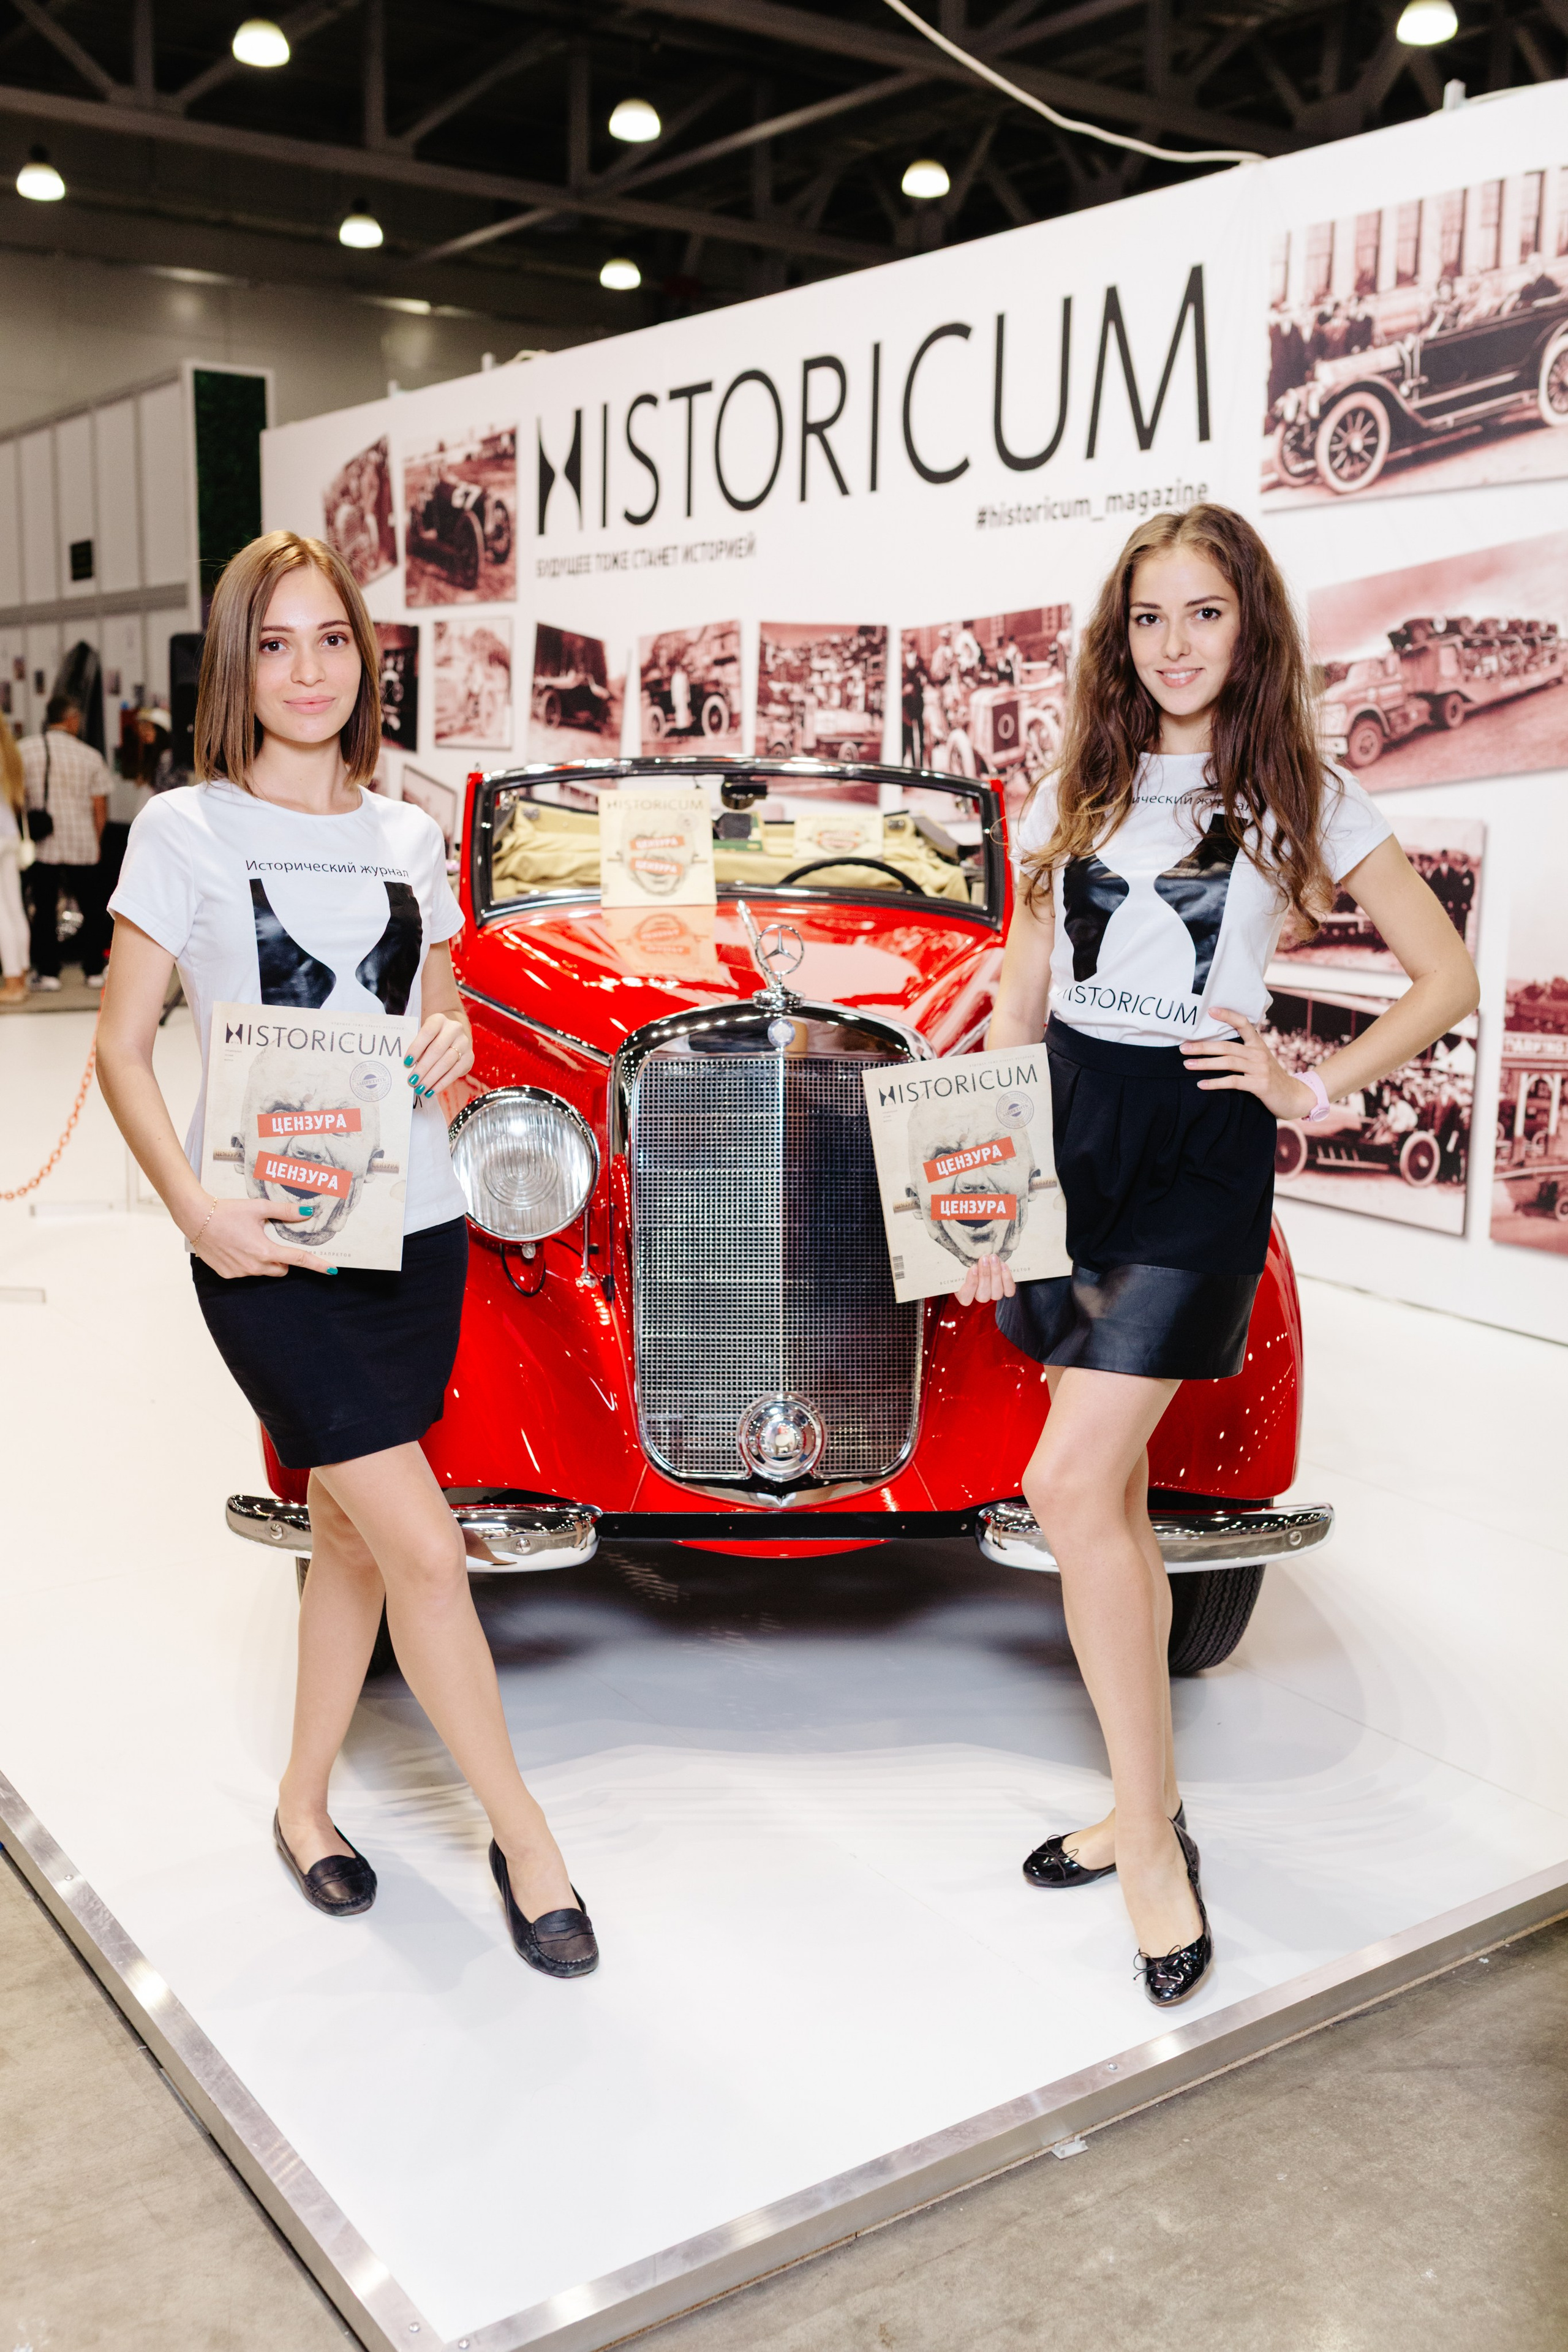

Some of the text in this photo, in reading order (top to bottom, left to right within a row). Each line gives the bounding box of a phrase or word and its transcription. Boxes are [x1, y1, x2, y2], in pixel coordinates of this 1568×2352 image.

[538, 263, 1210, 535] HISTORICUM
[976, 477, 1208, 529] #historicum_magazine
[536, 532, 756, 578] БУДУЩЕЕ ТОЖЕ СТАНЕТ ИСТОРИЕЙ
[1132, 793, 1193, 805] ический
[246, 860, 410, 878] Исторический журнал
[225, 1022, 402, 1057] HISTORICUM
[878, 1064, 1038, 1107] HISTORICUM
[271, 1114, 347, 1134] ЦЕНЗУРА
[265, 1160, 338, 1190] ЦЕНЗУРА
[936, 1144, 1003, 1176] ЦЕНЗУРА
[940, 1200, 1006, 1216] ЦЕНЗУРА
